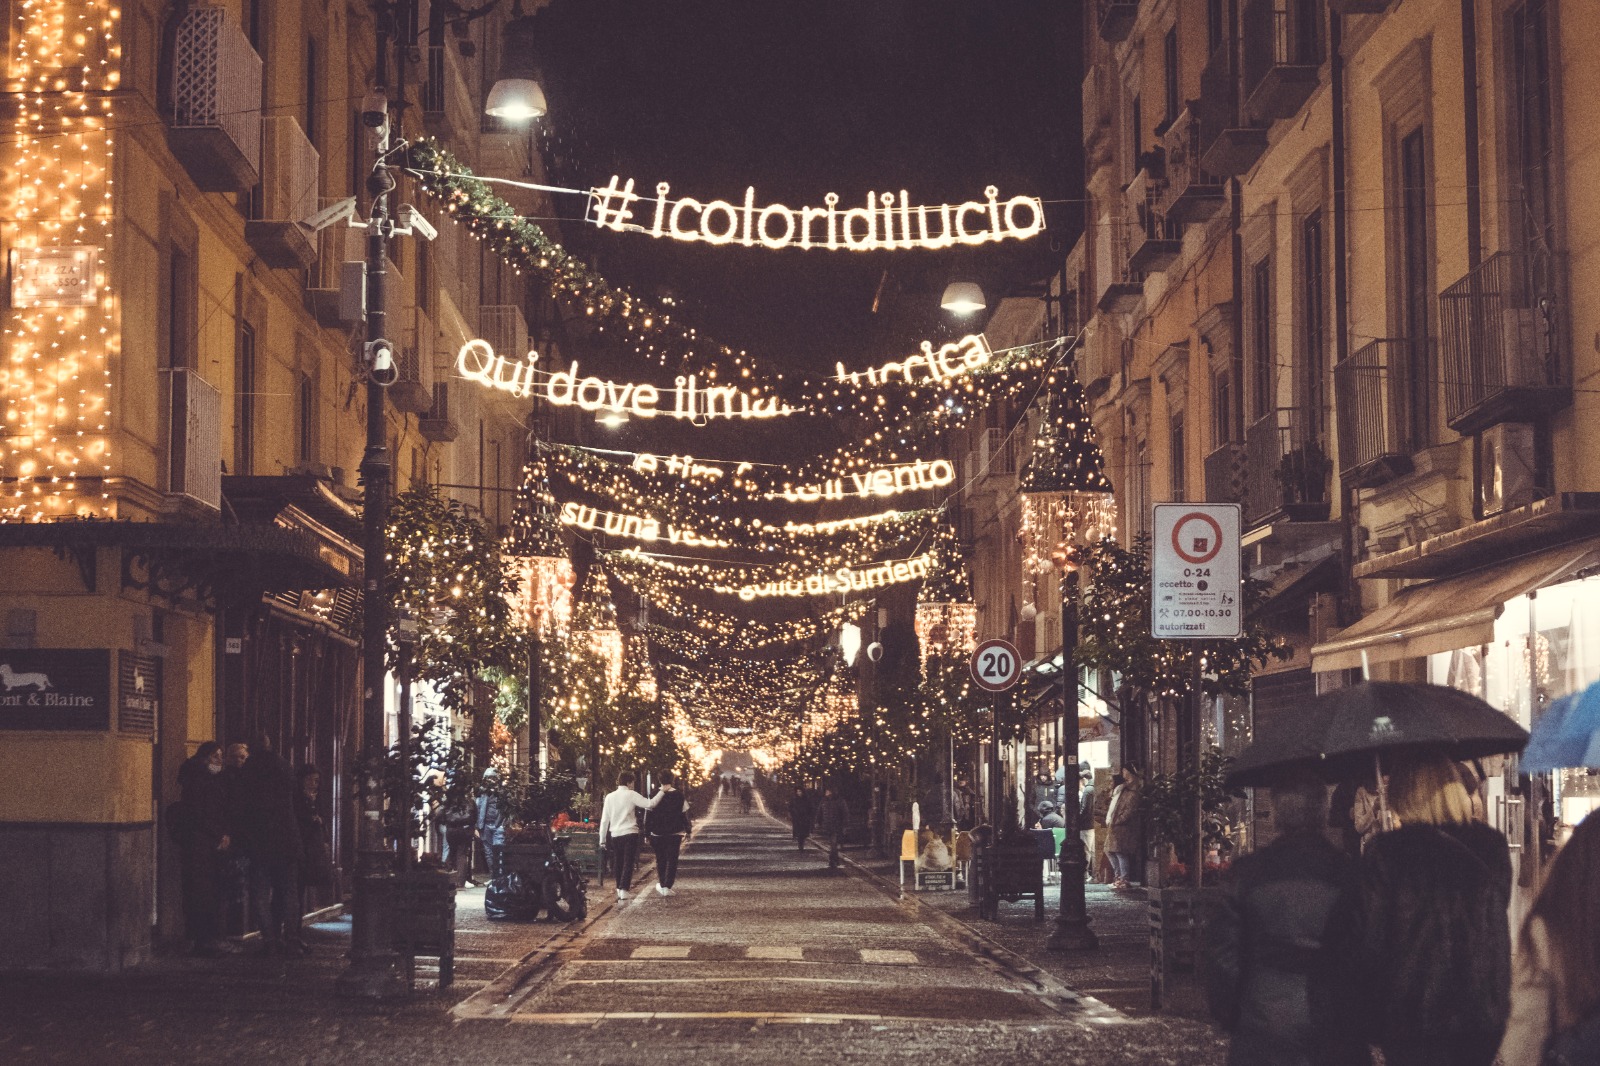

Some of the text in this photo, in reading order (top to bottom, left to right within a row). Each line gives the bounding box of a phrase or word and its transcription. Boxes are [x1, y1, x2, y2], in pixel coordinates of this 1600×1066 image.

[593, 175, 1042, 249] #icoloridilucio
[459, 338, 539, 397] Qui
[547, 360, 659, 417] dove
[674, 374, 696, 420] il
[852, 458, 951, 498] vento
[561, 502, 597, 530] su
[604, 515, 661, 541] una
[1159, 580, 1194, 588] eccetto:
[1183, 568, 1211, 578] 0-24
[1159, 622, 1206, 631] autorizzati
[982, 652, 1011, 677] 20
[26, 692, 40, 706] &
[44, 692, 94, 707] Blaine
